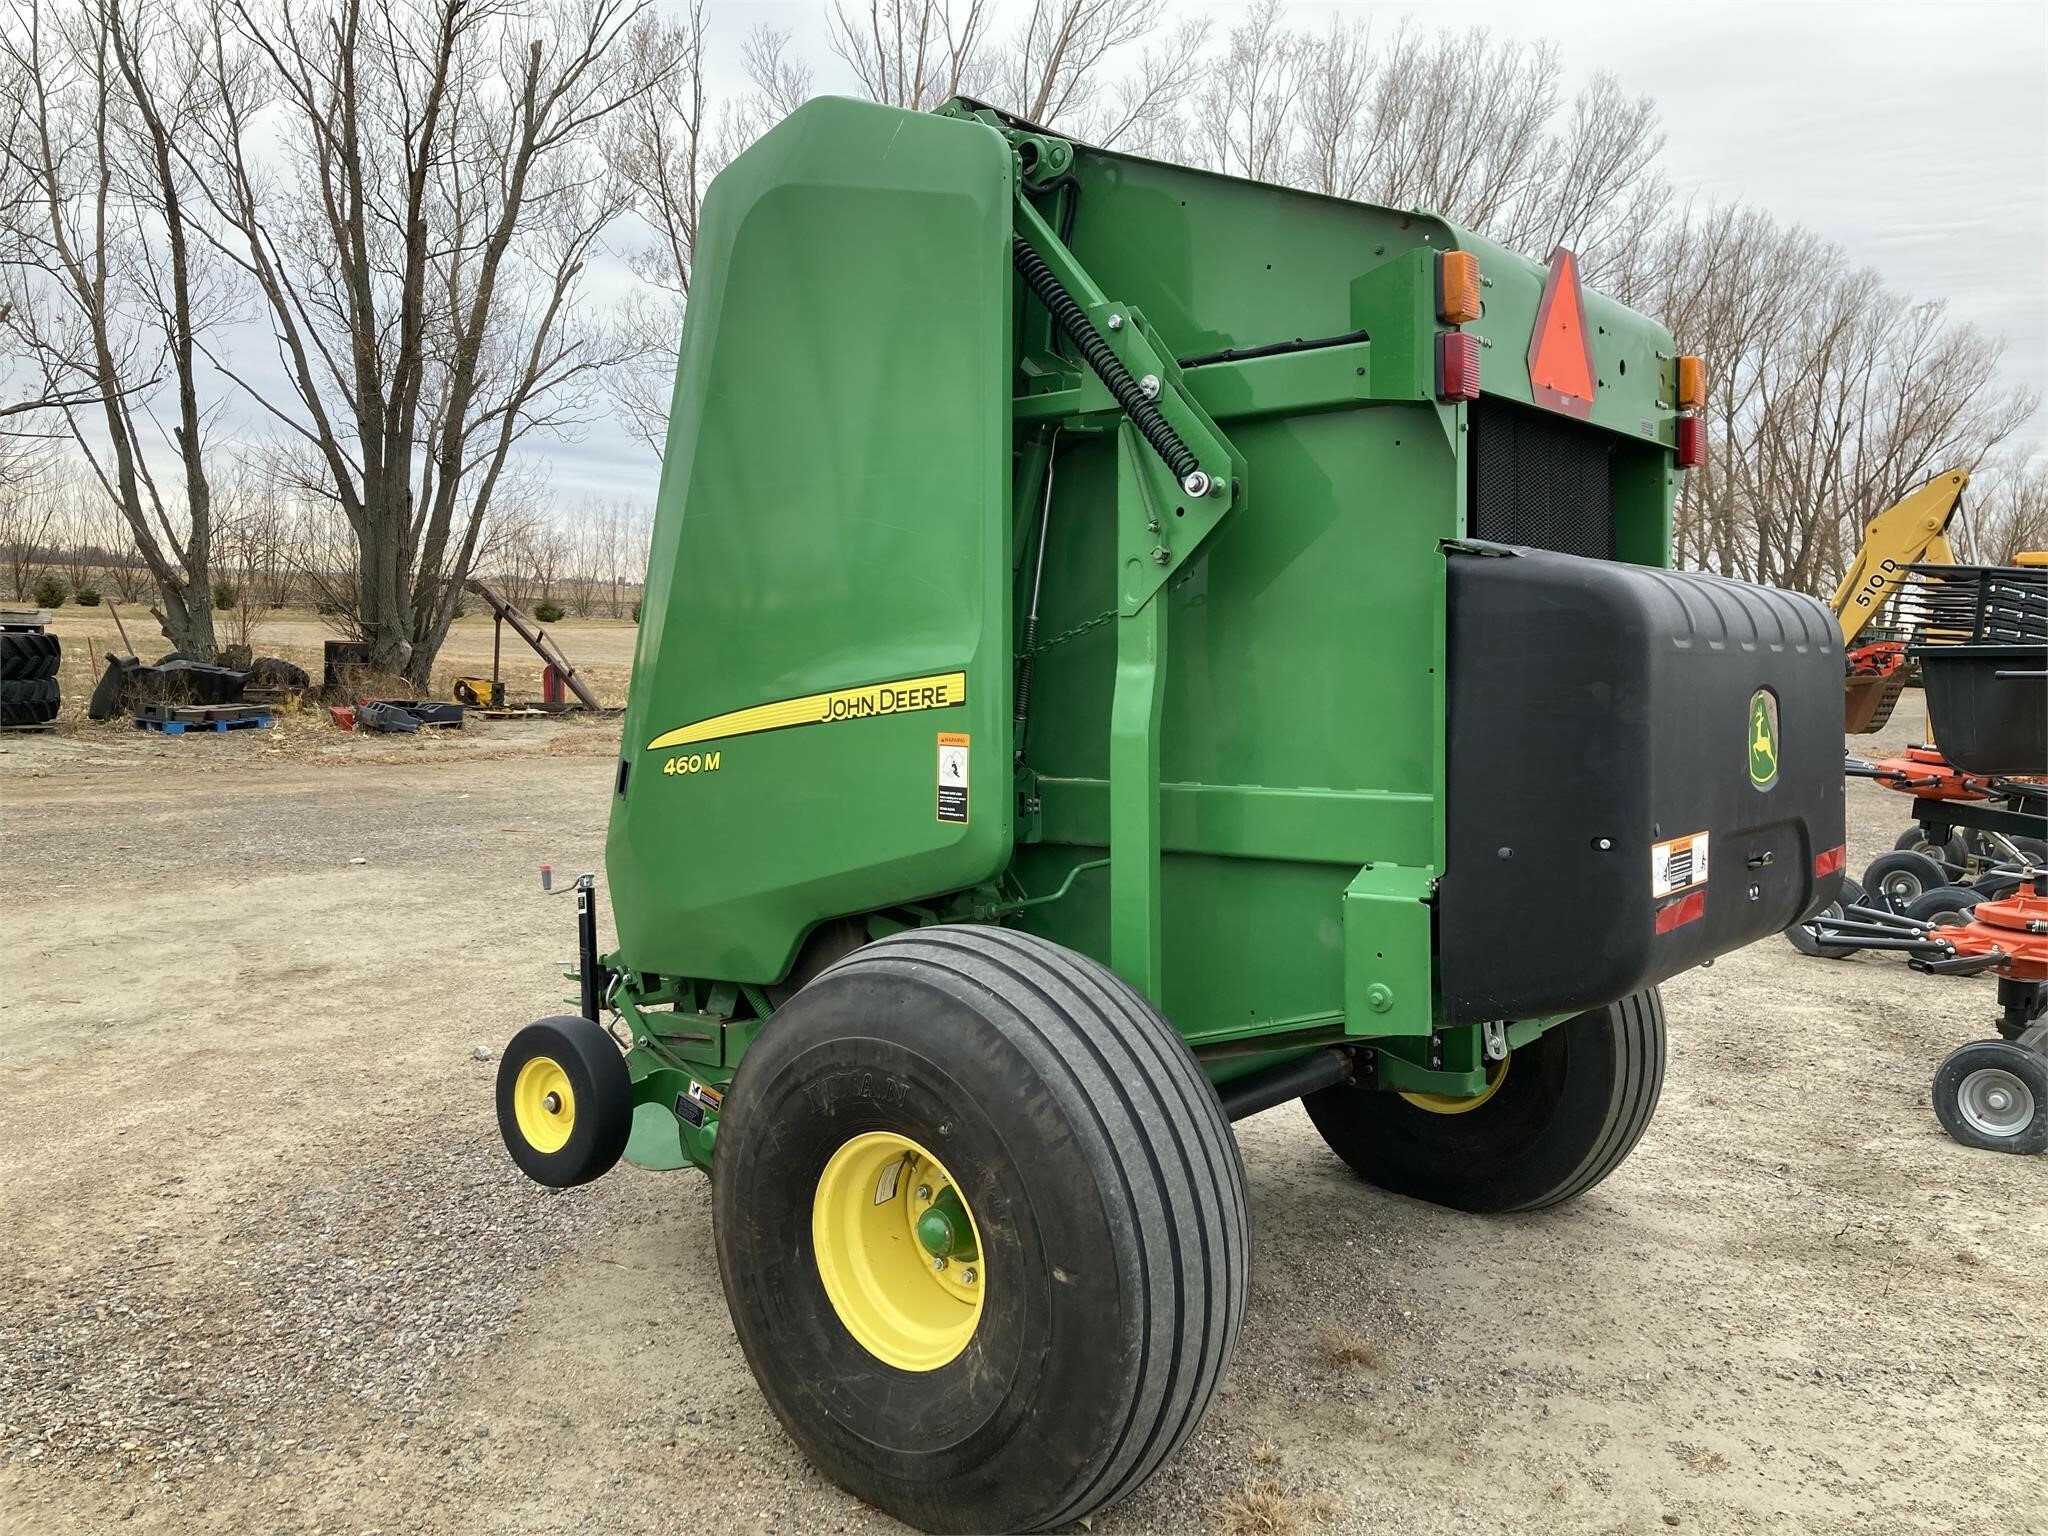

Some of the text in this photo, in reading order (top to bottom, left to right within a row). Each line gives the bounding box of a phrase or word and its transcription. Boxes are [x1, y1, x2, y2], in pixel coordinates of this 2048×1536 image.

[1855, 559, 1897, 607] 510 D
[822, 685, 948, 720] JOHN DEERE
[663, 751, 721, 776] 460 M
